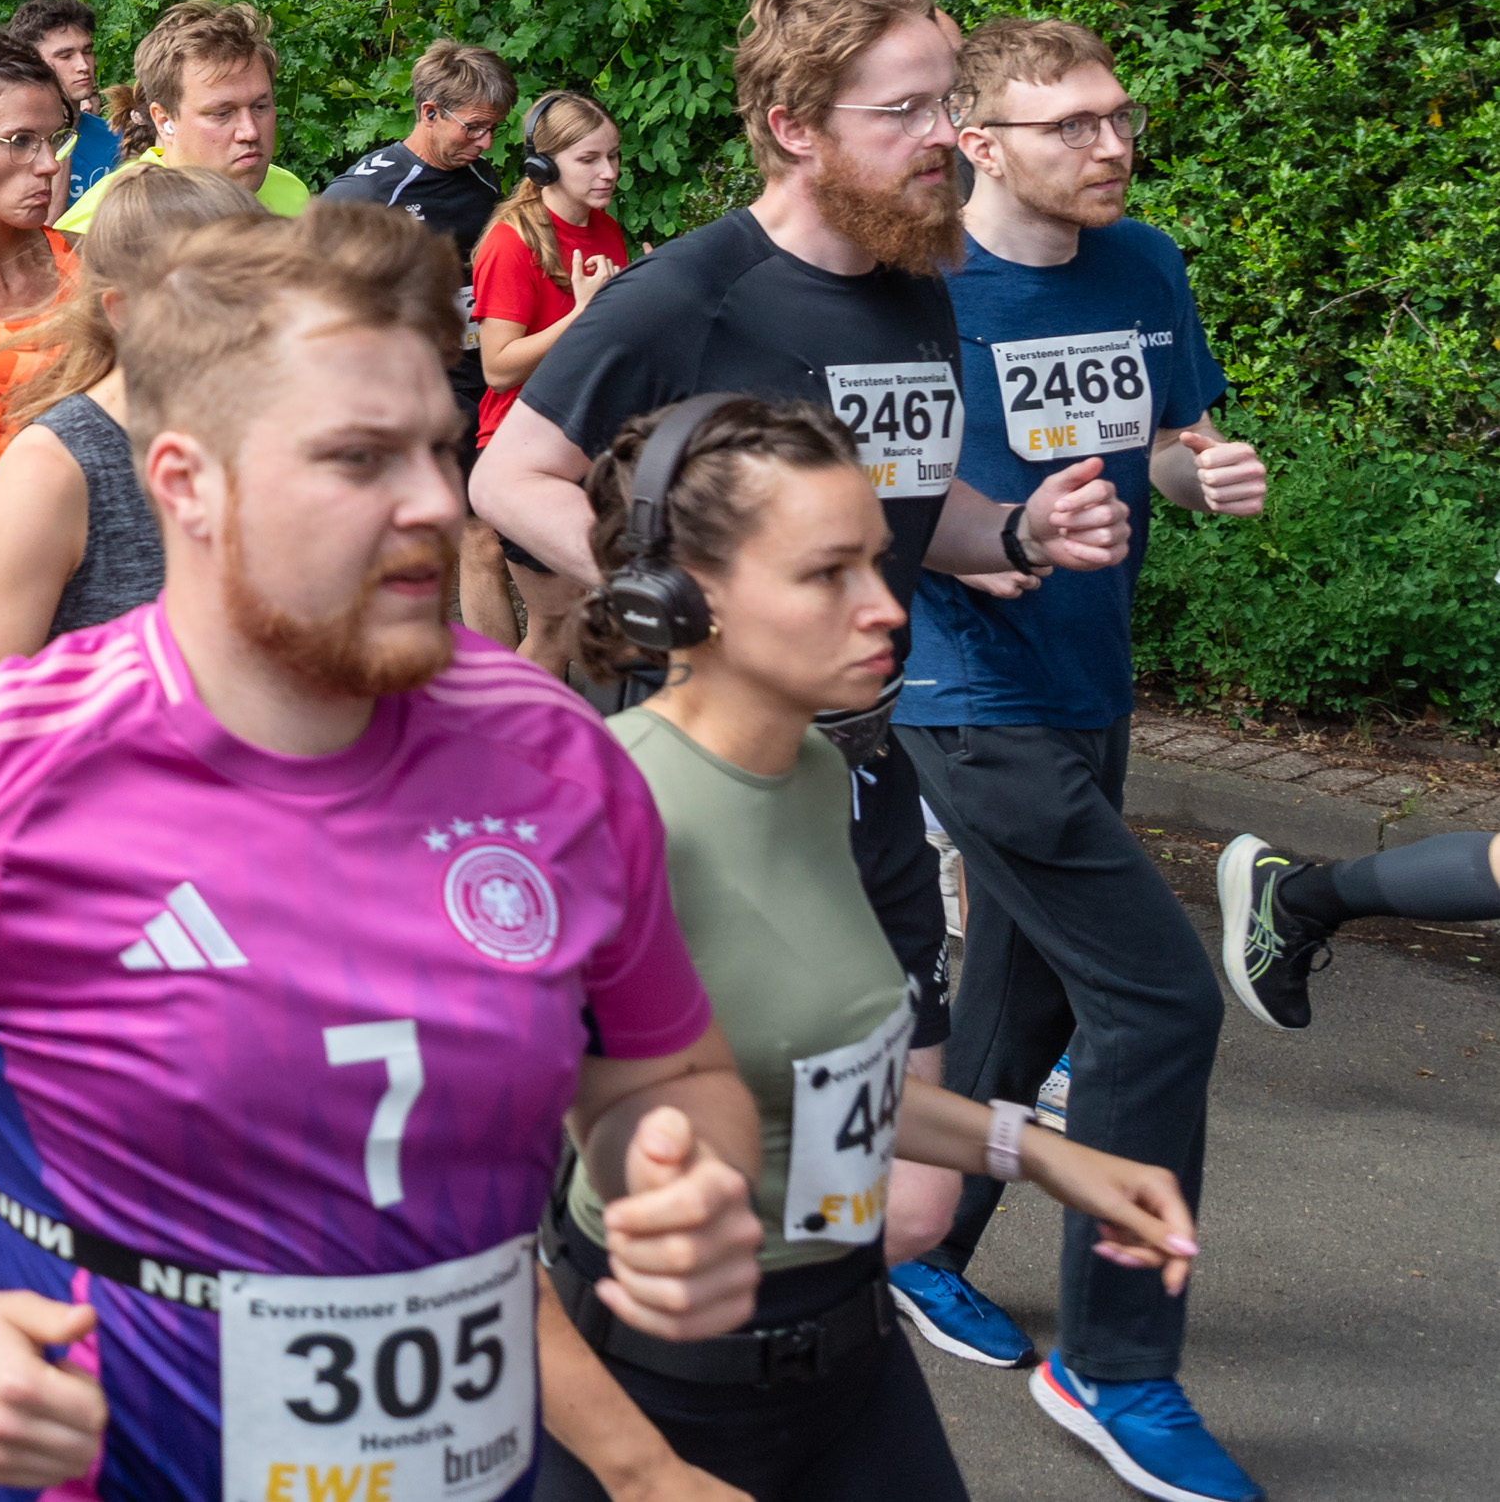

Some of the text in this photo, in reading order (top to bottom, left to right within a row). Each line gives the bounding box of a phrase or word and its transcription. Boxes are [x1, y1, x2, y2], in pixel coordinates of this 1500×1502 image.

[1006, 341, 1131, 362] Everstener Brunnenlauf
[839, 373, 947, 387] Everstener Brunnenlauf
[1005, 355, 1144, 412] 2468
[839, 389, 956, 444] 2467
[1065, 410, 1095, 420] Peter
[1098, 420, 1140, 439] bruns
[883, 447, 923, 457] Maurice
[1029, 425, 1077, 450] EWE
[865, 462, 896, 487] WE
[323, 1019, 424, 1210] 7
[250, 1258, 520, 1320] Everstener Brunnenlauf
[285, 1302, 504, 1426] 305
[360, 1423, 455, 1452] Hendrik
[444, 1427, 518, 1485] bruns
[264, 1461, 396, 1502] EWE
